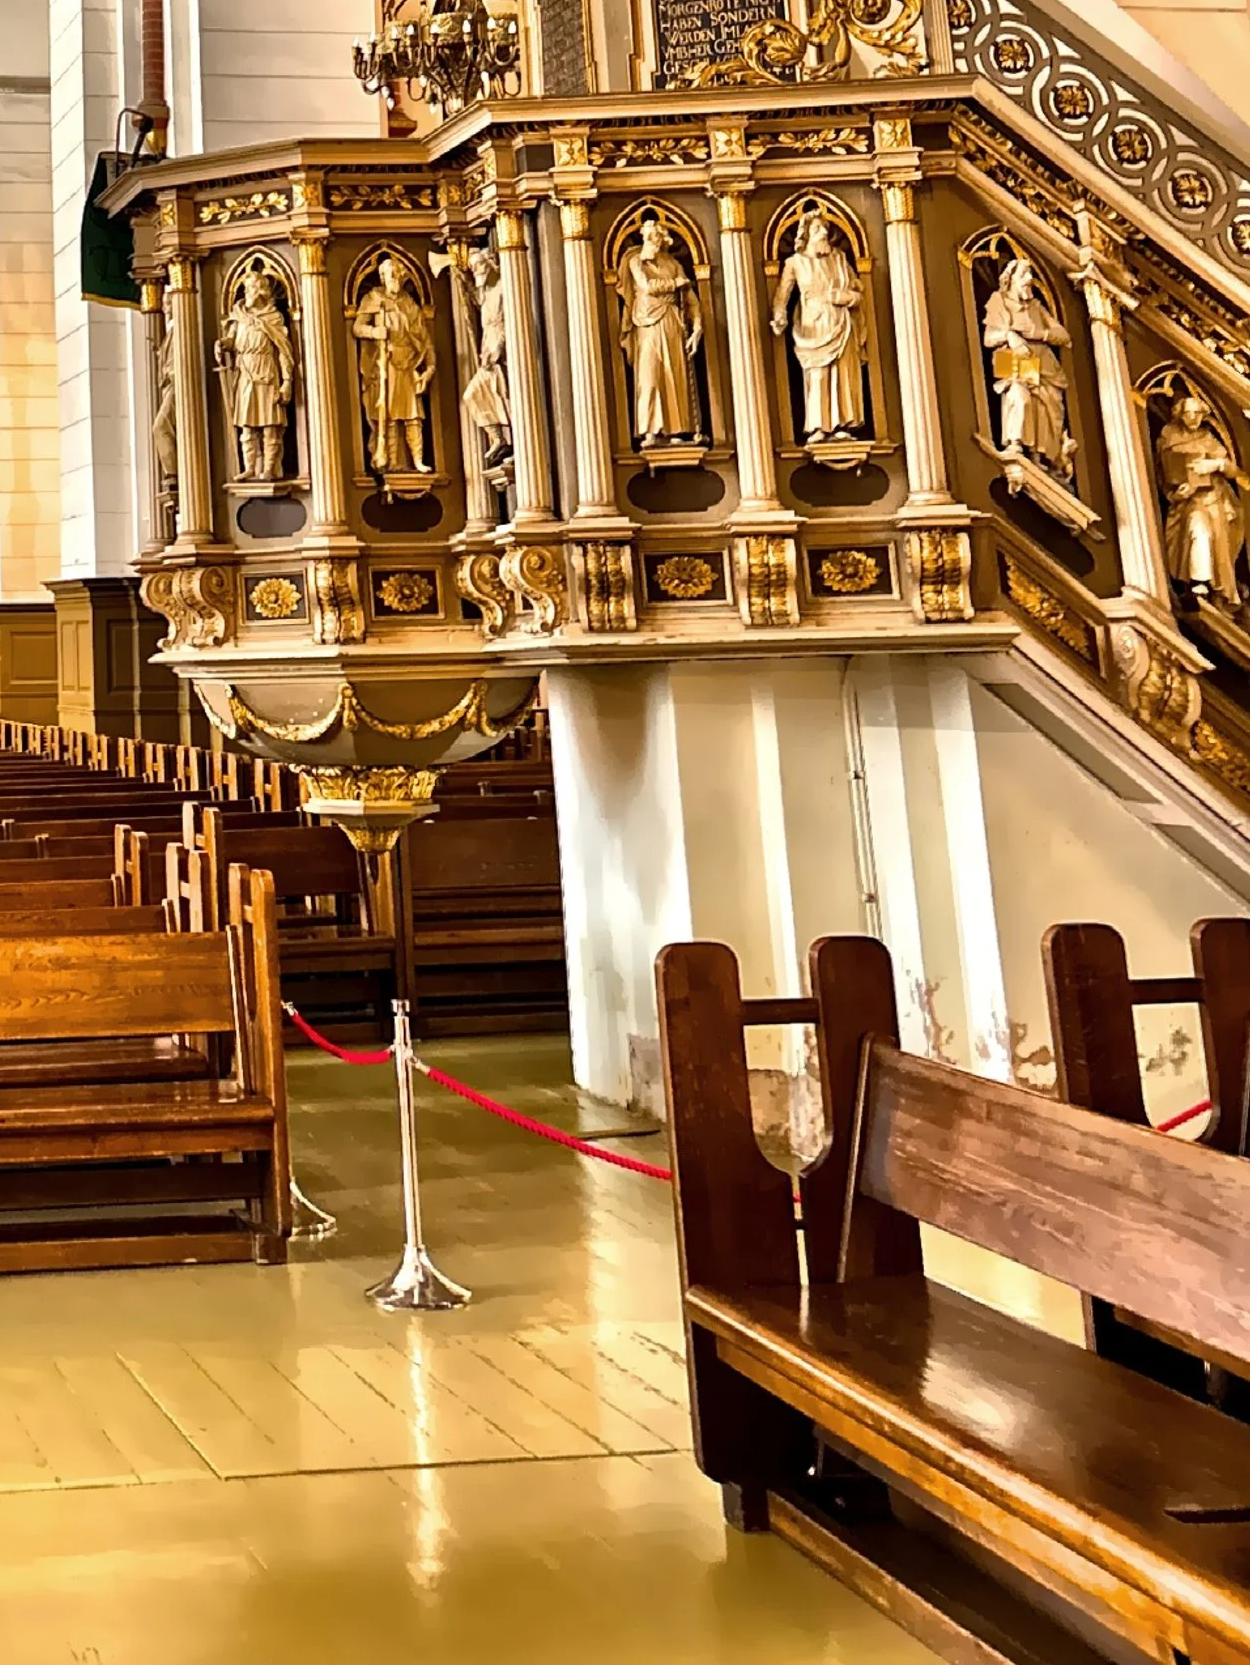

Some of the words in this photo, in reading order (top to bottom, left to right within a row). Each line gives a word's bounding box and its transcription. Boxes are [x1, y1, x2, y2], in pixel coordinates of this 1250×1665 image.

[660, 15, 702, 34] HABEN
[710, 5, 776, 26] SONDERN
[664, 27, 716, 46] WERDEN
